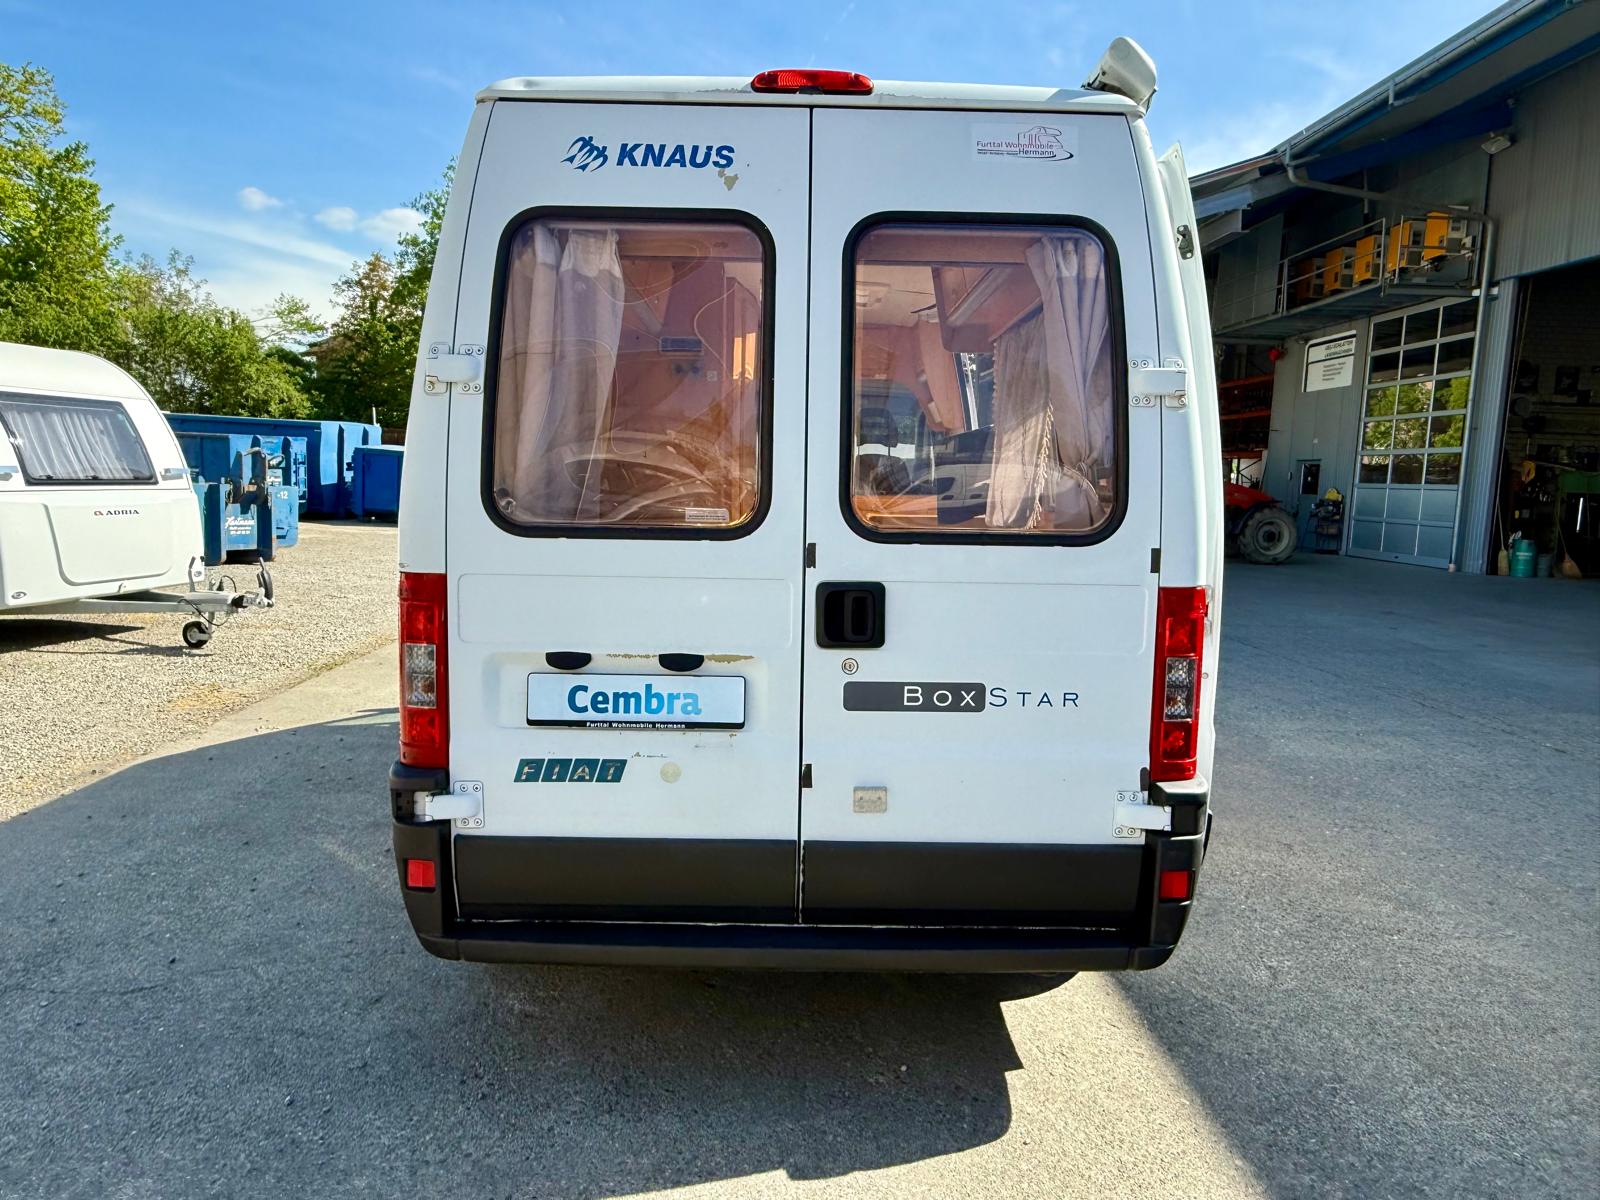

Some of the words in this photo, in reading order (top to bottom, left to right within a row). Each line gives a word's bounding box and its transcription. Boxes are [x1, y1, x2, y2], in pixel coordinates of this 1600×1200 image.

[976, 140, 1003, 148] Furttal
[1018, 148, 1055, 156] Hermann
[616, 143, 736, 168] KNAUS
[567, 683, 703, 716] Cembra
[518, 761, 623, 781] FIAT
